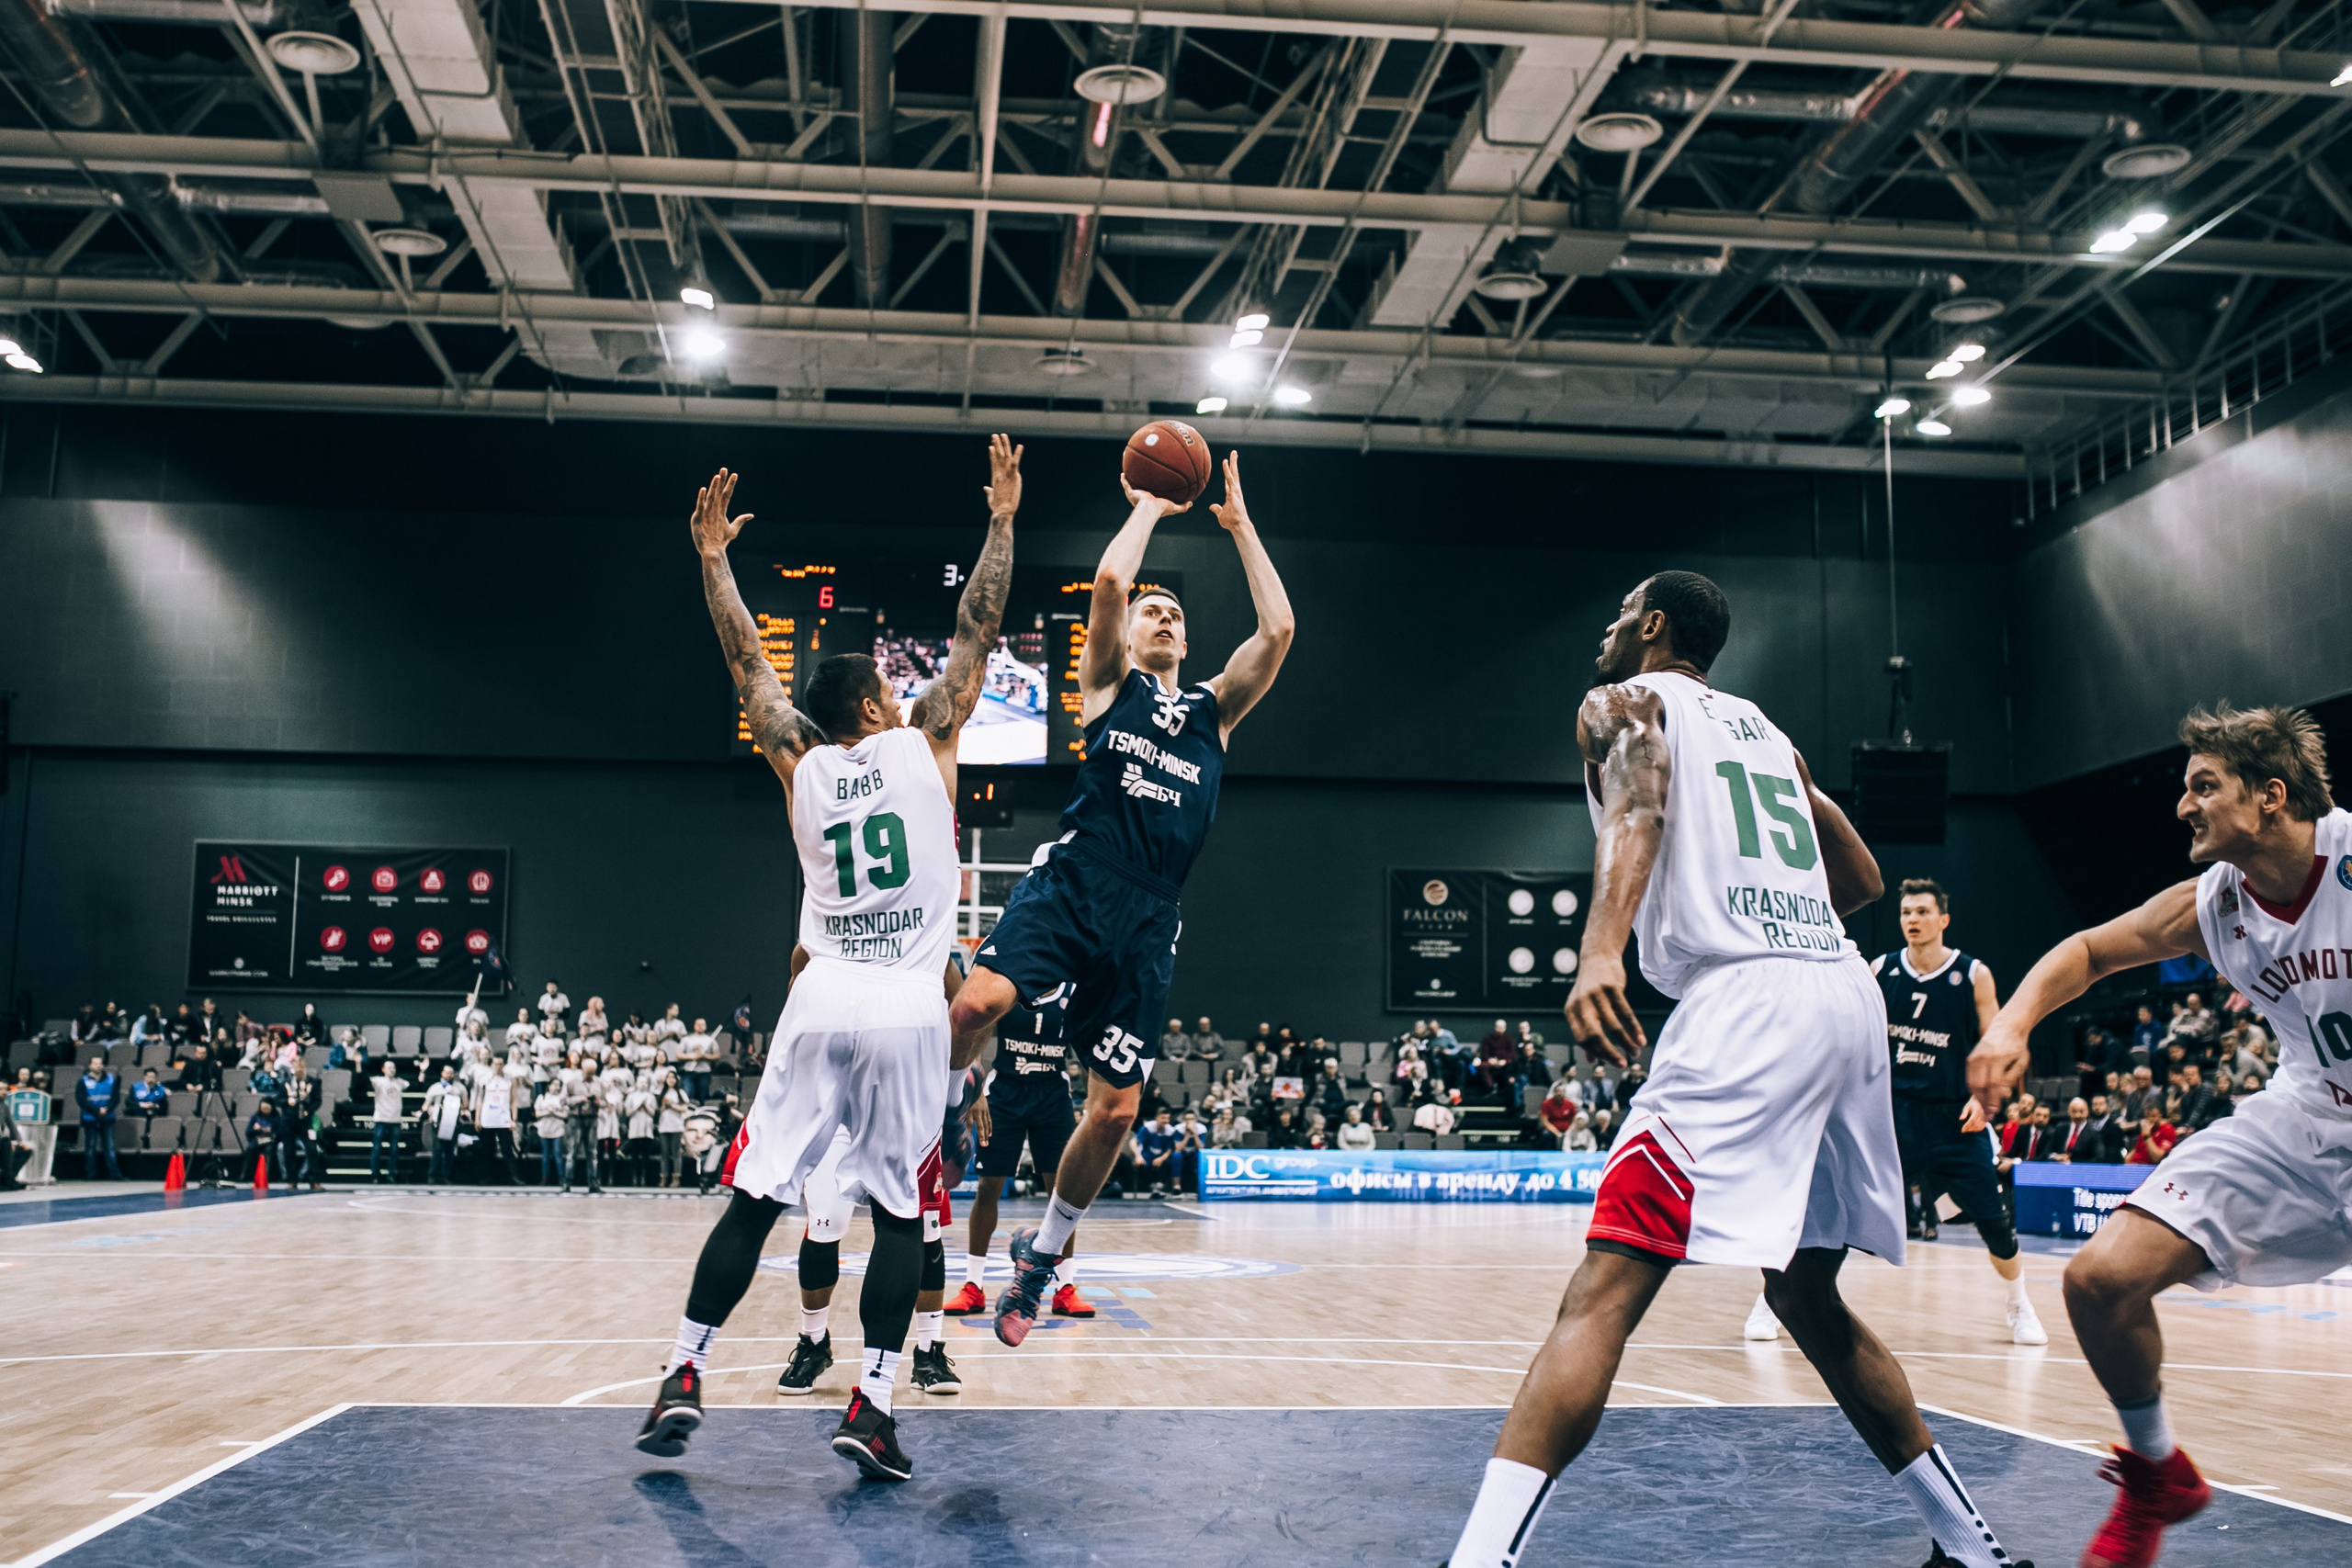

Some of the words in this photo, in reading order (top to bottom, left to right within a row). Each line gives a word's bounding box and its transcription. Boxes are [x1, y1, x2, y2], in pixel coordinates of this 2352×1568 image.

[819, 586, 834, 608] 6
[1152, 694, 1190, 737] 35
[1697, 697, 1772, 741] EGAR
[837, 769, 884, 800] BABB
[1715, 761, 1818, 871] 15
[823, 812, 910, 898] 19
[216, 897, 253, 907] MINSK
[217, 885, 278, 897] MARRIOTT
[823, 908, 924, 936] KRASNODAR
[1403, 908, 1468, 922] FALCON
[1727, 886, 1840, 931] KRASNODA
[373, 933, 391, 945] VIP
[839, 938, 902, 958] REGION
[1762, 922, 1839, 953] REGION
[2250, 948, 2352, 1004] LOOMOT
[1912, 992, 1928, 1019] 7
[1035, 1012, 1043, 1034] 1
[1888, 1023, 1951, 1048] SMOKI-MINSK
[1004, 1038, 1066, 1057] TSMOKI-MINSK
[1092, 1024, 1145, 1074] 35
[1205, 1155, 1271, 1179] IDC
[1330, 1167, 1412, 1195] офисы
[1436, 1172, 1521, 1195] аренду
[1525, 1173, 1555, 1192] до
[1559, 1169, 1573, 1190] 4
